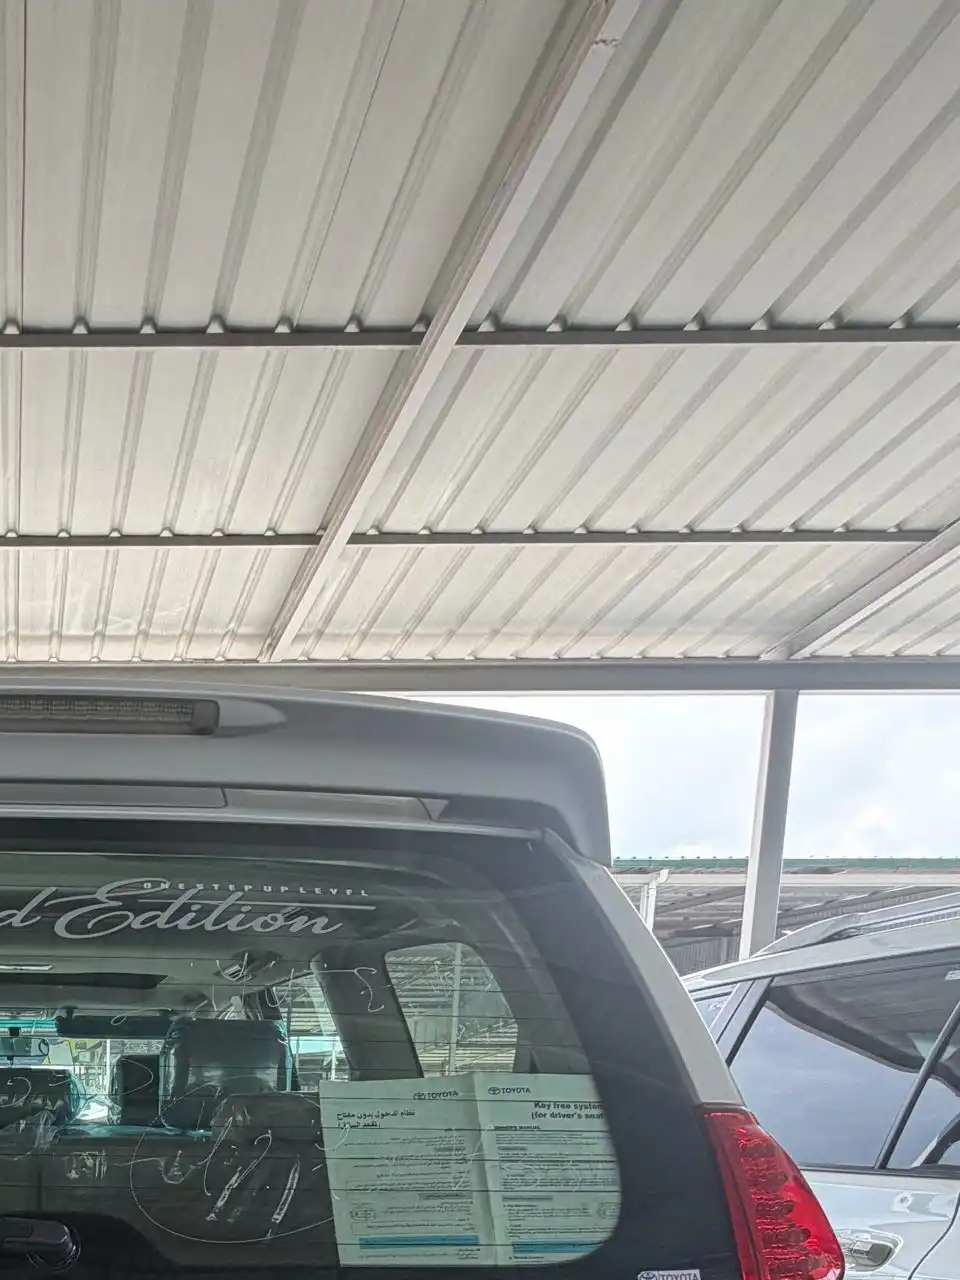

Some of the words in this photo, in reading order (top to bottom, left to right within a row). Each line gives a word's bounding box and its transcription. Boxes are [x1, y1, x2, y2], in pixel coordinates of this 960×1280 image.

[44, 876, 344, 940] Edition
[427, 1089, 459, 1099] TOYOTA
[500, 1086, 532, 1095] TOYOTA
[534, 1101, 551, 1110] Key
[553, 1102, 571, 1110] free
[549, 1111, 582, 1120] driver's
